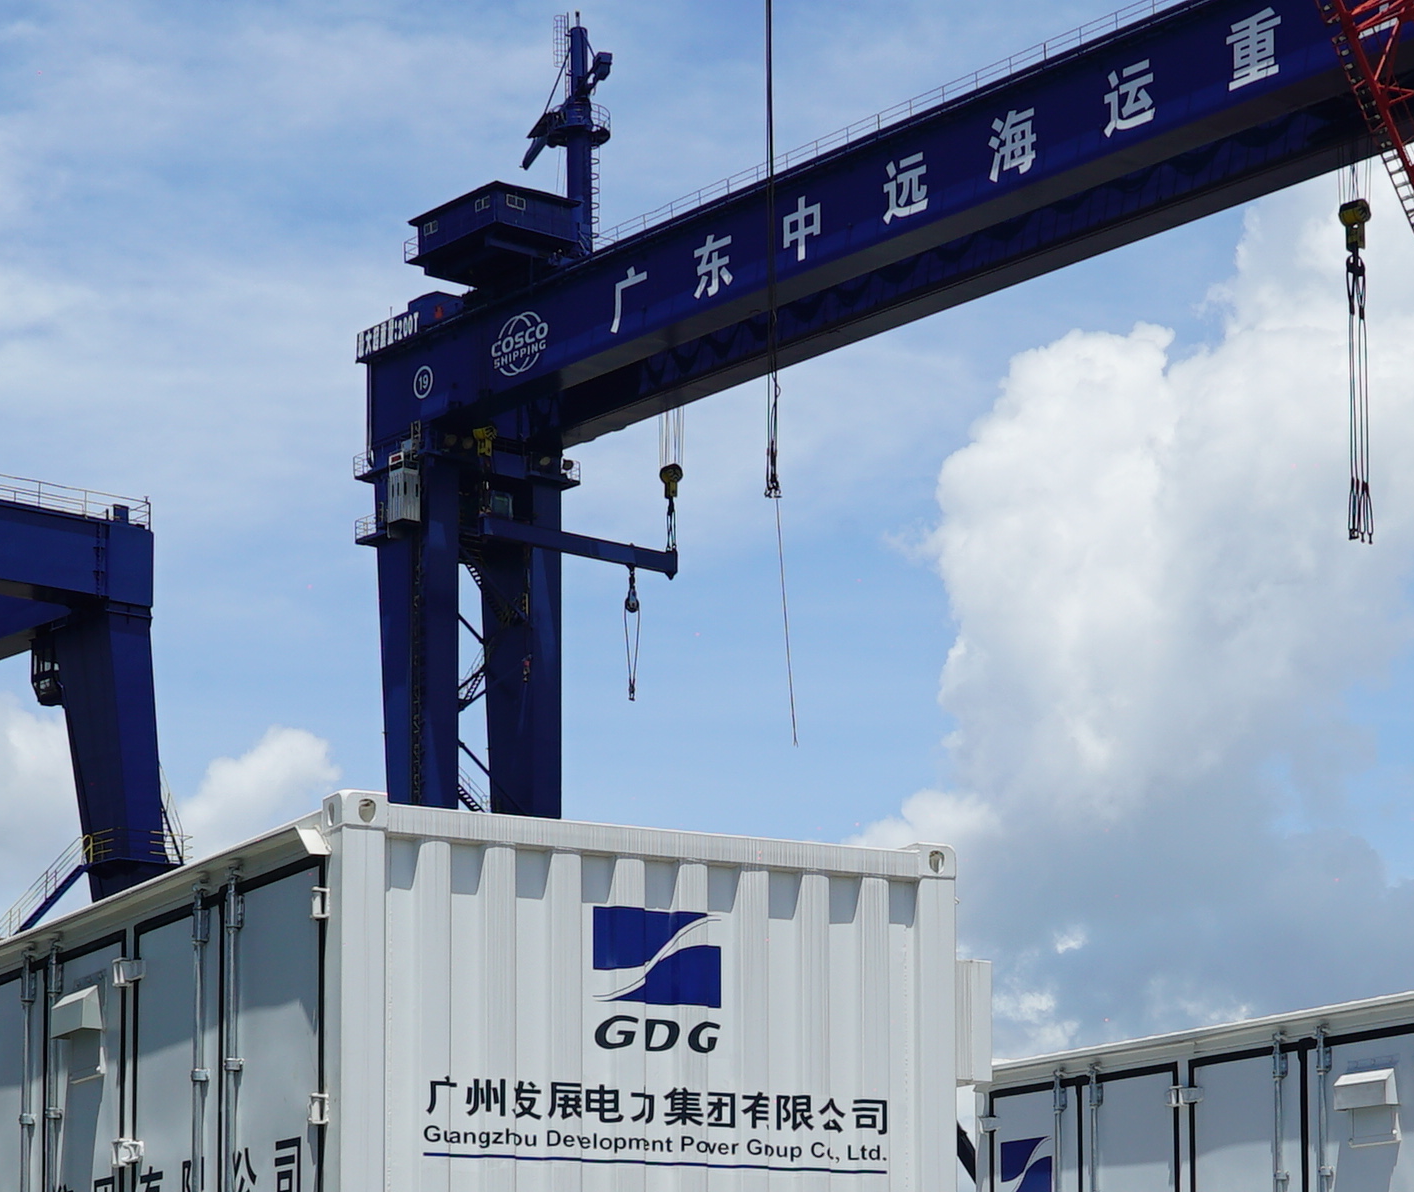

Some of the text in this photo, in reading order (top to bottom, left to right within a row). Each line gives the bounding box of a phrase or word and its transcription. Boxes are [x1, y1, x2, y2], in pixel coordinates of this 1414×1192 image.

[491, 322, 549, 358] COSCO
[494, 340, 547, 370] SHIPPING
[418, 375, 430, 391] 19
[594, 1014, 722, 1054] GDG
[425, 1075, 889, 1136] 广州发展电力集团有限公司
[847, 1144, 888, 1164] Ltd.
